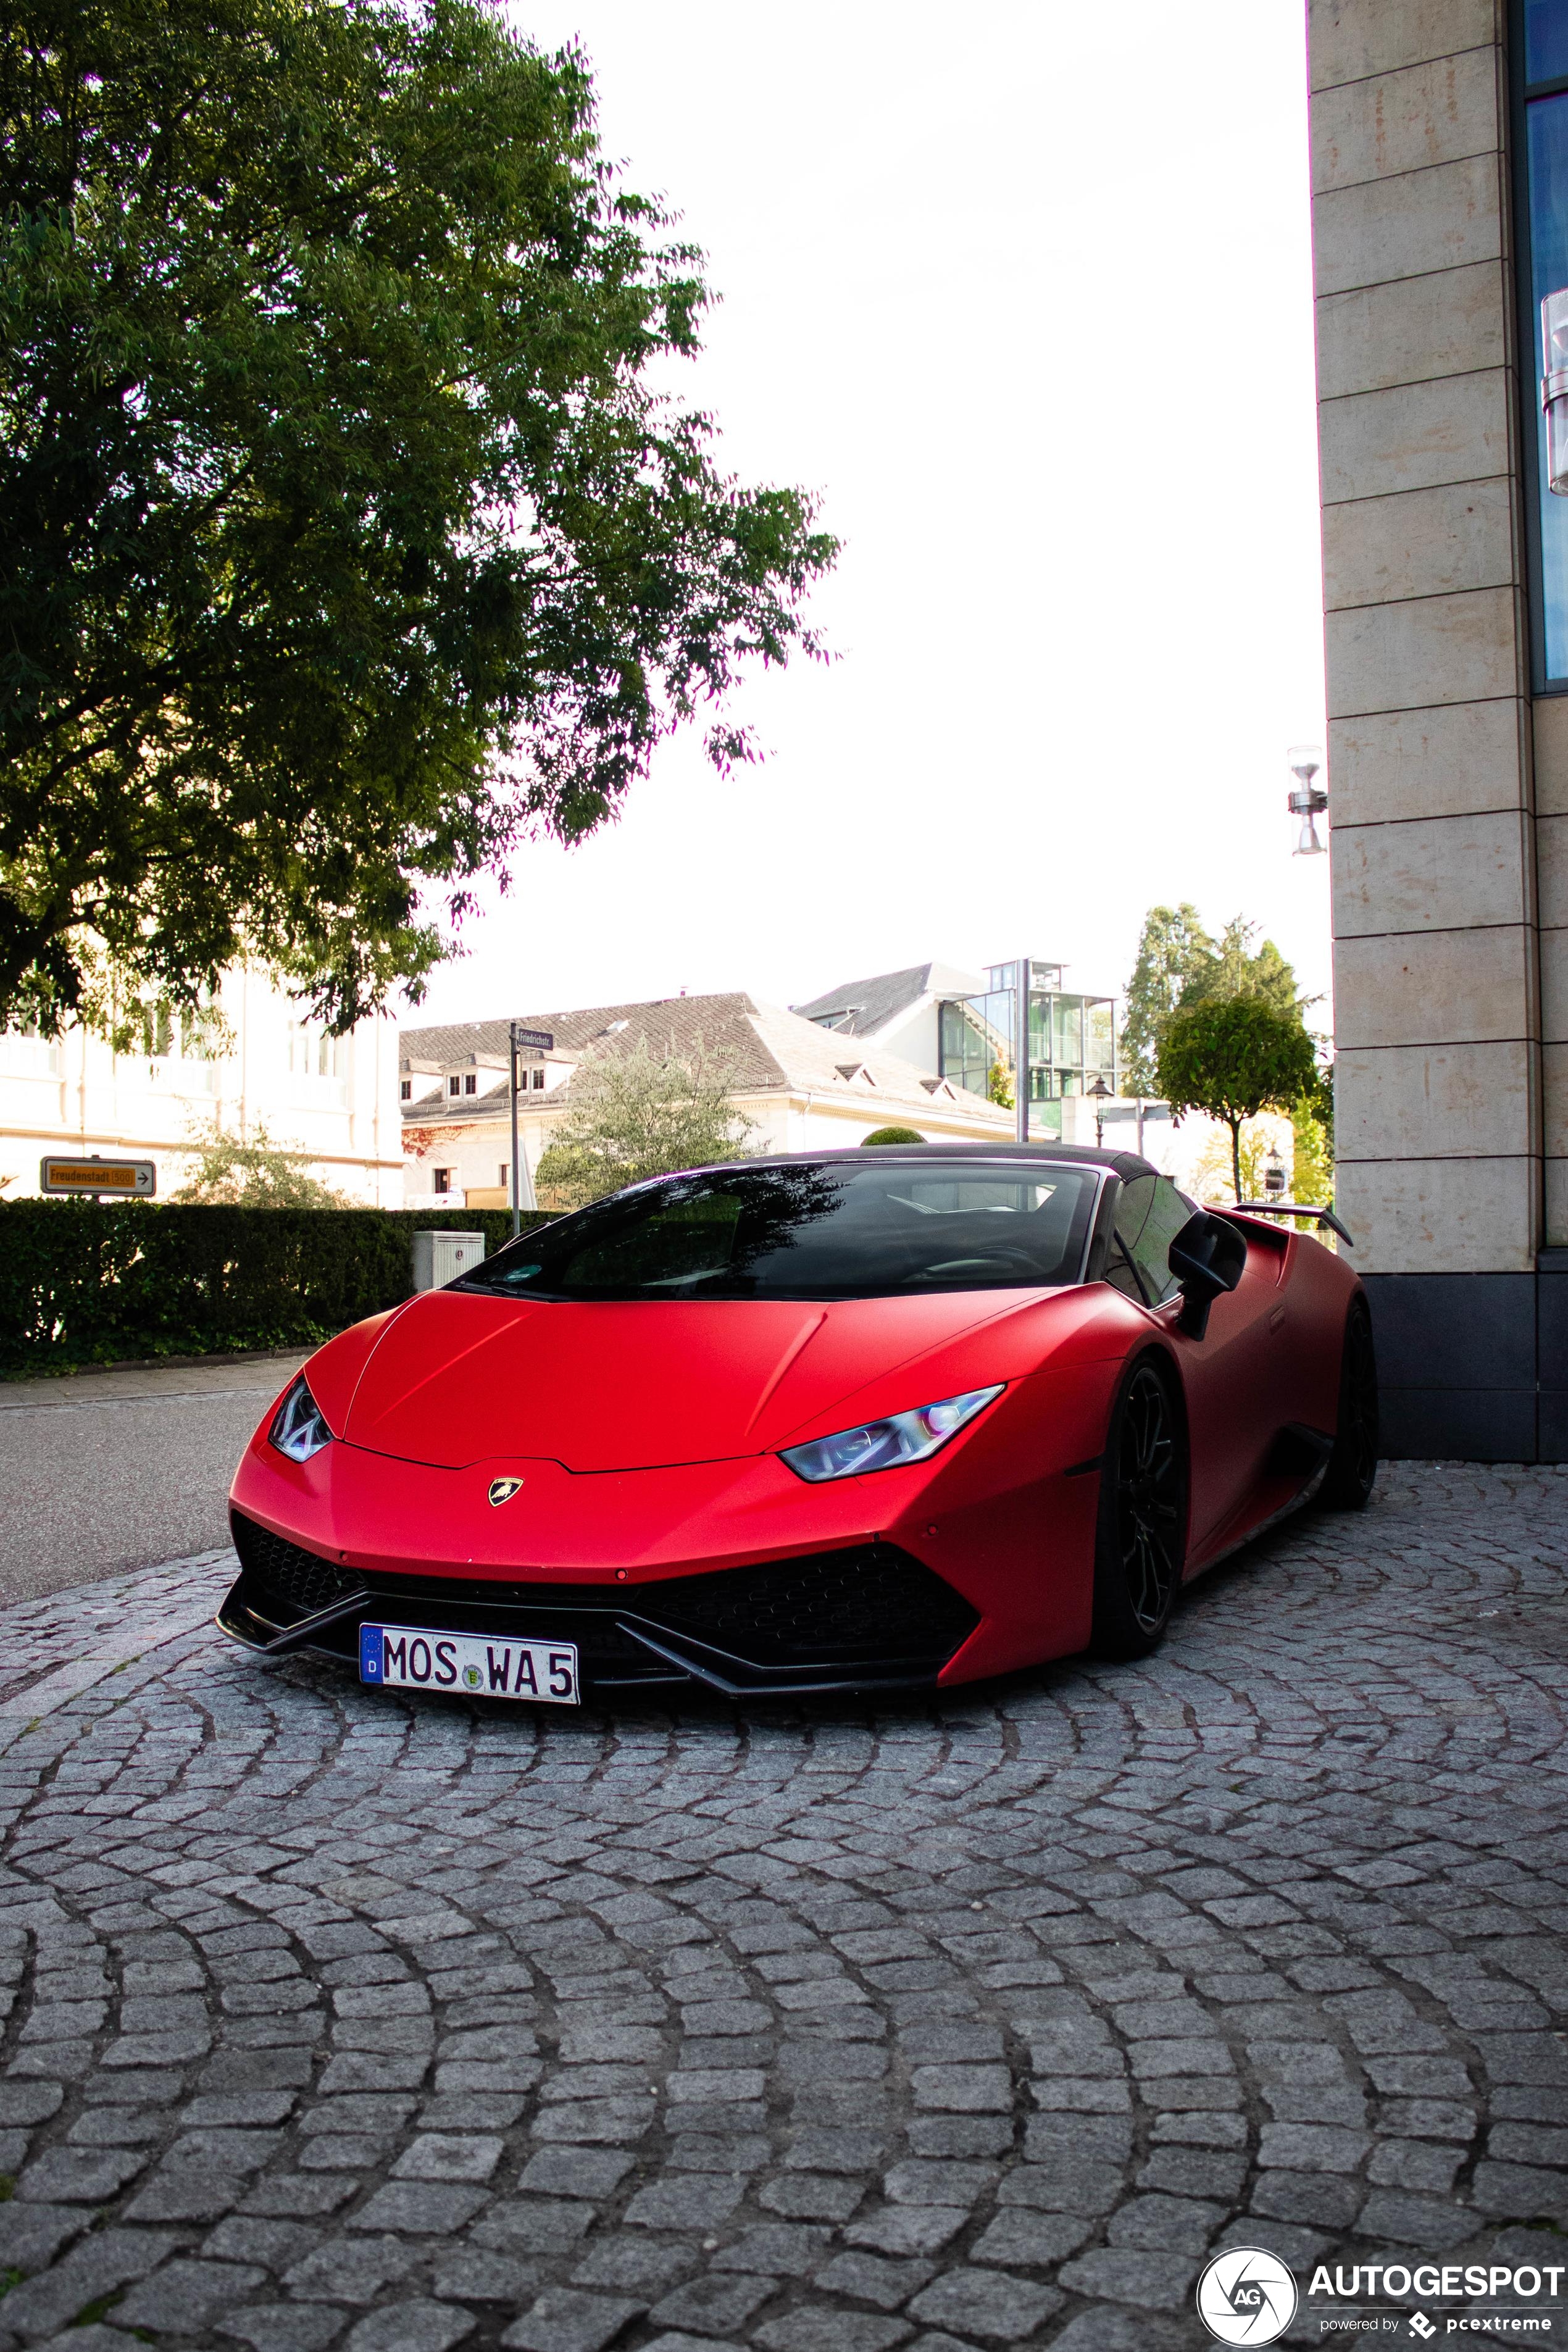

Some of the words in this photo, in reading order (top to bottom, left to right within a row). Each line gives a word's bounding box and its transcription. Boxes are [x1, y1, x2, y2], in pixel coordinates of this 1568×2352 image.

[520, 1032, 551, 1047] Friedrichstr.
[51, 1169, 109, 1183] Freudenstadt
[114, 1173, 130, 1182] 500
[368, 1661, 377, 1673] D
[383, 1635, 458, 1685] MOS
[486, 1645, 538, 1695] WA
[549, 1651, 572, 1697] 5
